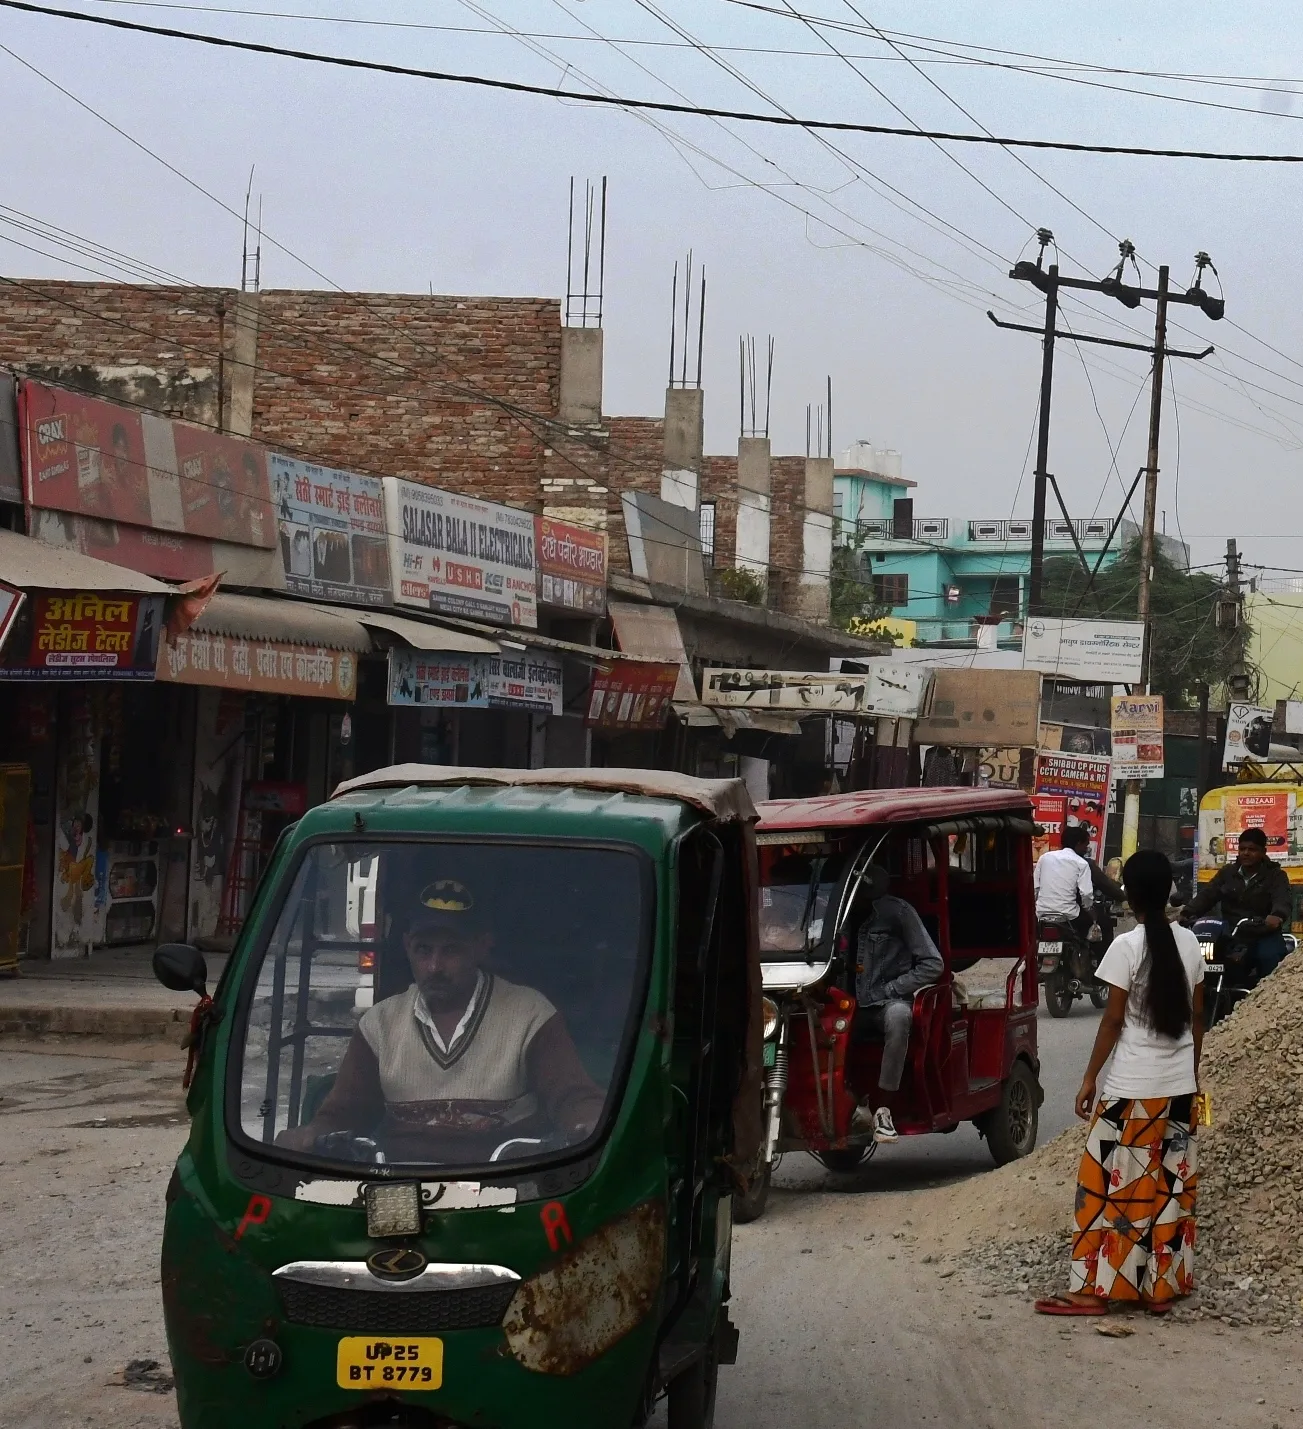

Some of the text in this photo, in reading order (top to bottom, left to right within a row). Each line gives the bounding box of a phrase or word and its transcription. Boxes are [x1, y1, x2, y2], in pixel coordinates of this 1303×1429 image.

[38, 420, 64, 444] CRAX
[402, 504, 443, 550] SALASAR
[446, 515, 468, 557] BALA
[478, 523, 533, 571] ELECTRICALS
[558, 533, 578, 567] पनीर
[447, 565, 481, 587] USHA
[485, 572, 504, 587] KEI
[45, 592, 133, 622] अनिल
[38, 624, 132, 651] लेडीज टेलर
[1115, 700, 1159, 713] Aarvi
[1040, 766, 1059, 777] CCTV
[1060, 769, 1089, 780] CAMERA
[1090, 774, 1095, 782] &
[1049, 758, 1077, 770] SHIBBU
[1077, 761, 1088, 771] CP
[1089, 763, 1107, 773] PLUS
[366, 1342, 419, 1361] UP25
[349, 1365, 432, 1382] BT 8779
